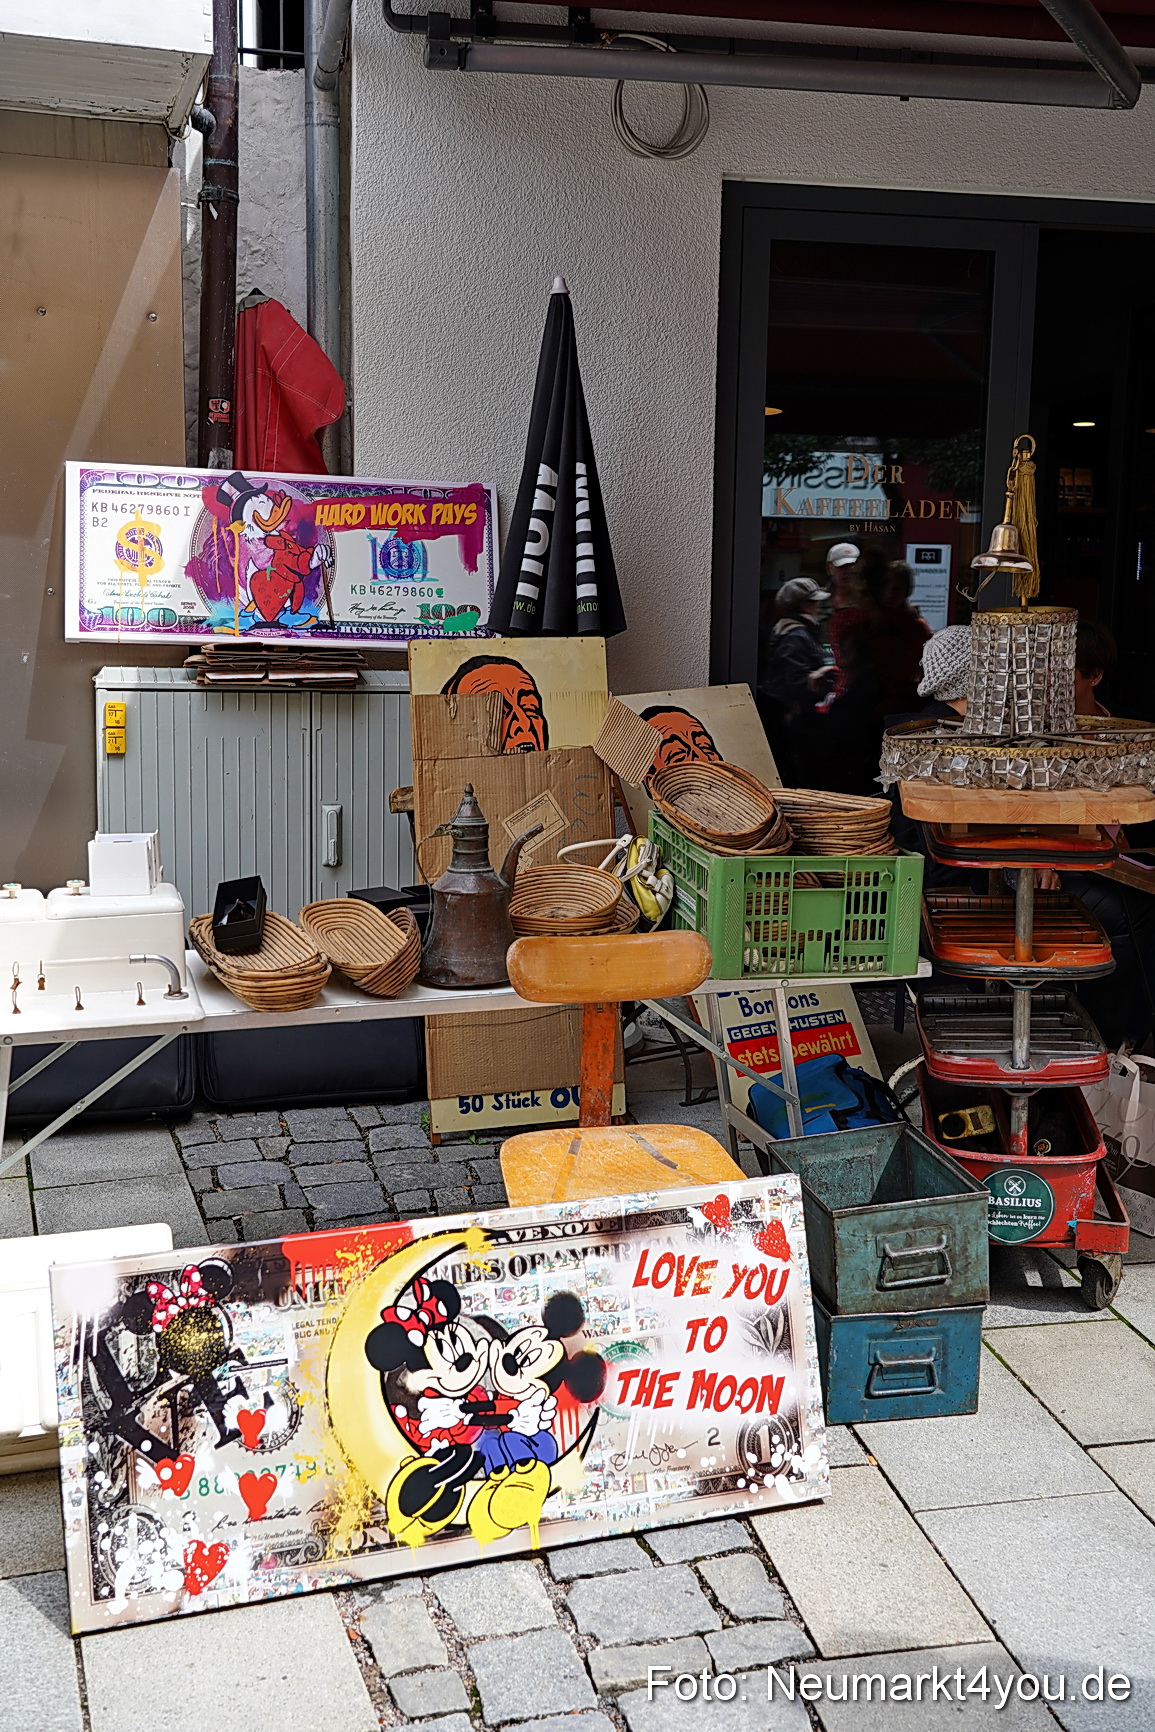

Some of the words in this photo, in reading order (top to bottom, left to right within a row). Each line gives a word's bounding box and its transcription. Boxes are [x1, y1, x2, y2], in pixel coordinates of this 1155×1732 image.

[137, 490, 181, 498] RESERVE
[774, 487, 971, 519] KAFFEELADEN
[92, 517, 108, 527] B2
[315, 503, 366, 526] HARD
[370, 502, 427, 526] WORK
[431, 503, 478, 525] PAYS
[340, 625, 416, 636] HUNDRED
[738, 990, 820, 1017] Bonons
[738, 1045, 780, 1067] stets
[458, 1094, 484, 1115] 50
[491, 1090, 542, 1111] Stück
[988, 1196, 1042, 1208] BASILIUS
[632, 1249, 719, 1298] LOVE
[722, 1263, 790, 1306] YOU
[686, 1316, 728, 1354] TO
[617, 1367, 681, 1410] THE
[686, 1369, 785, 1415] MOON
[707, 1427, 721, 1447] 2
